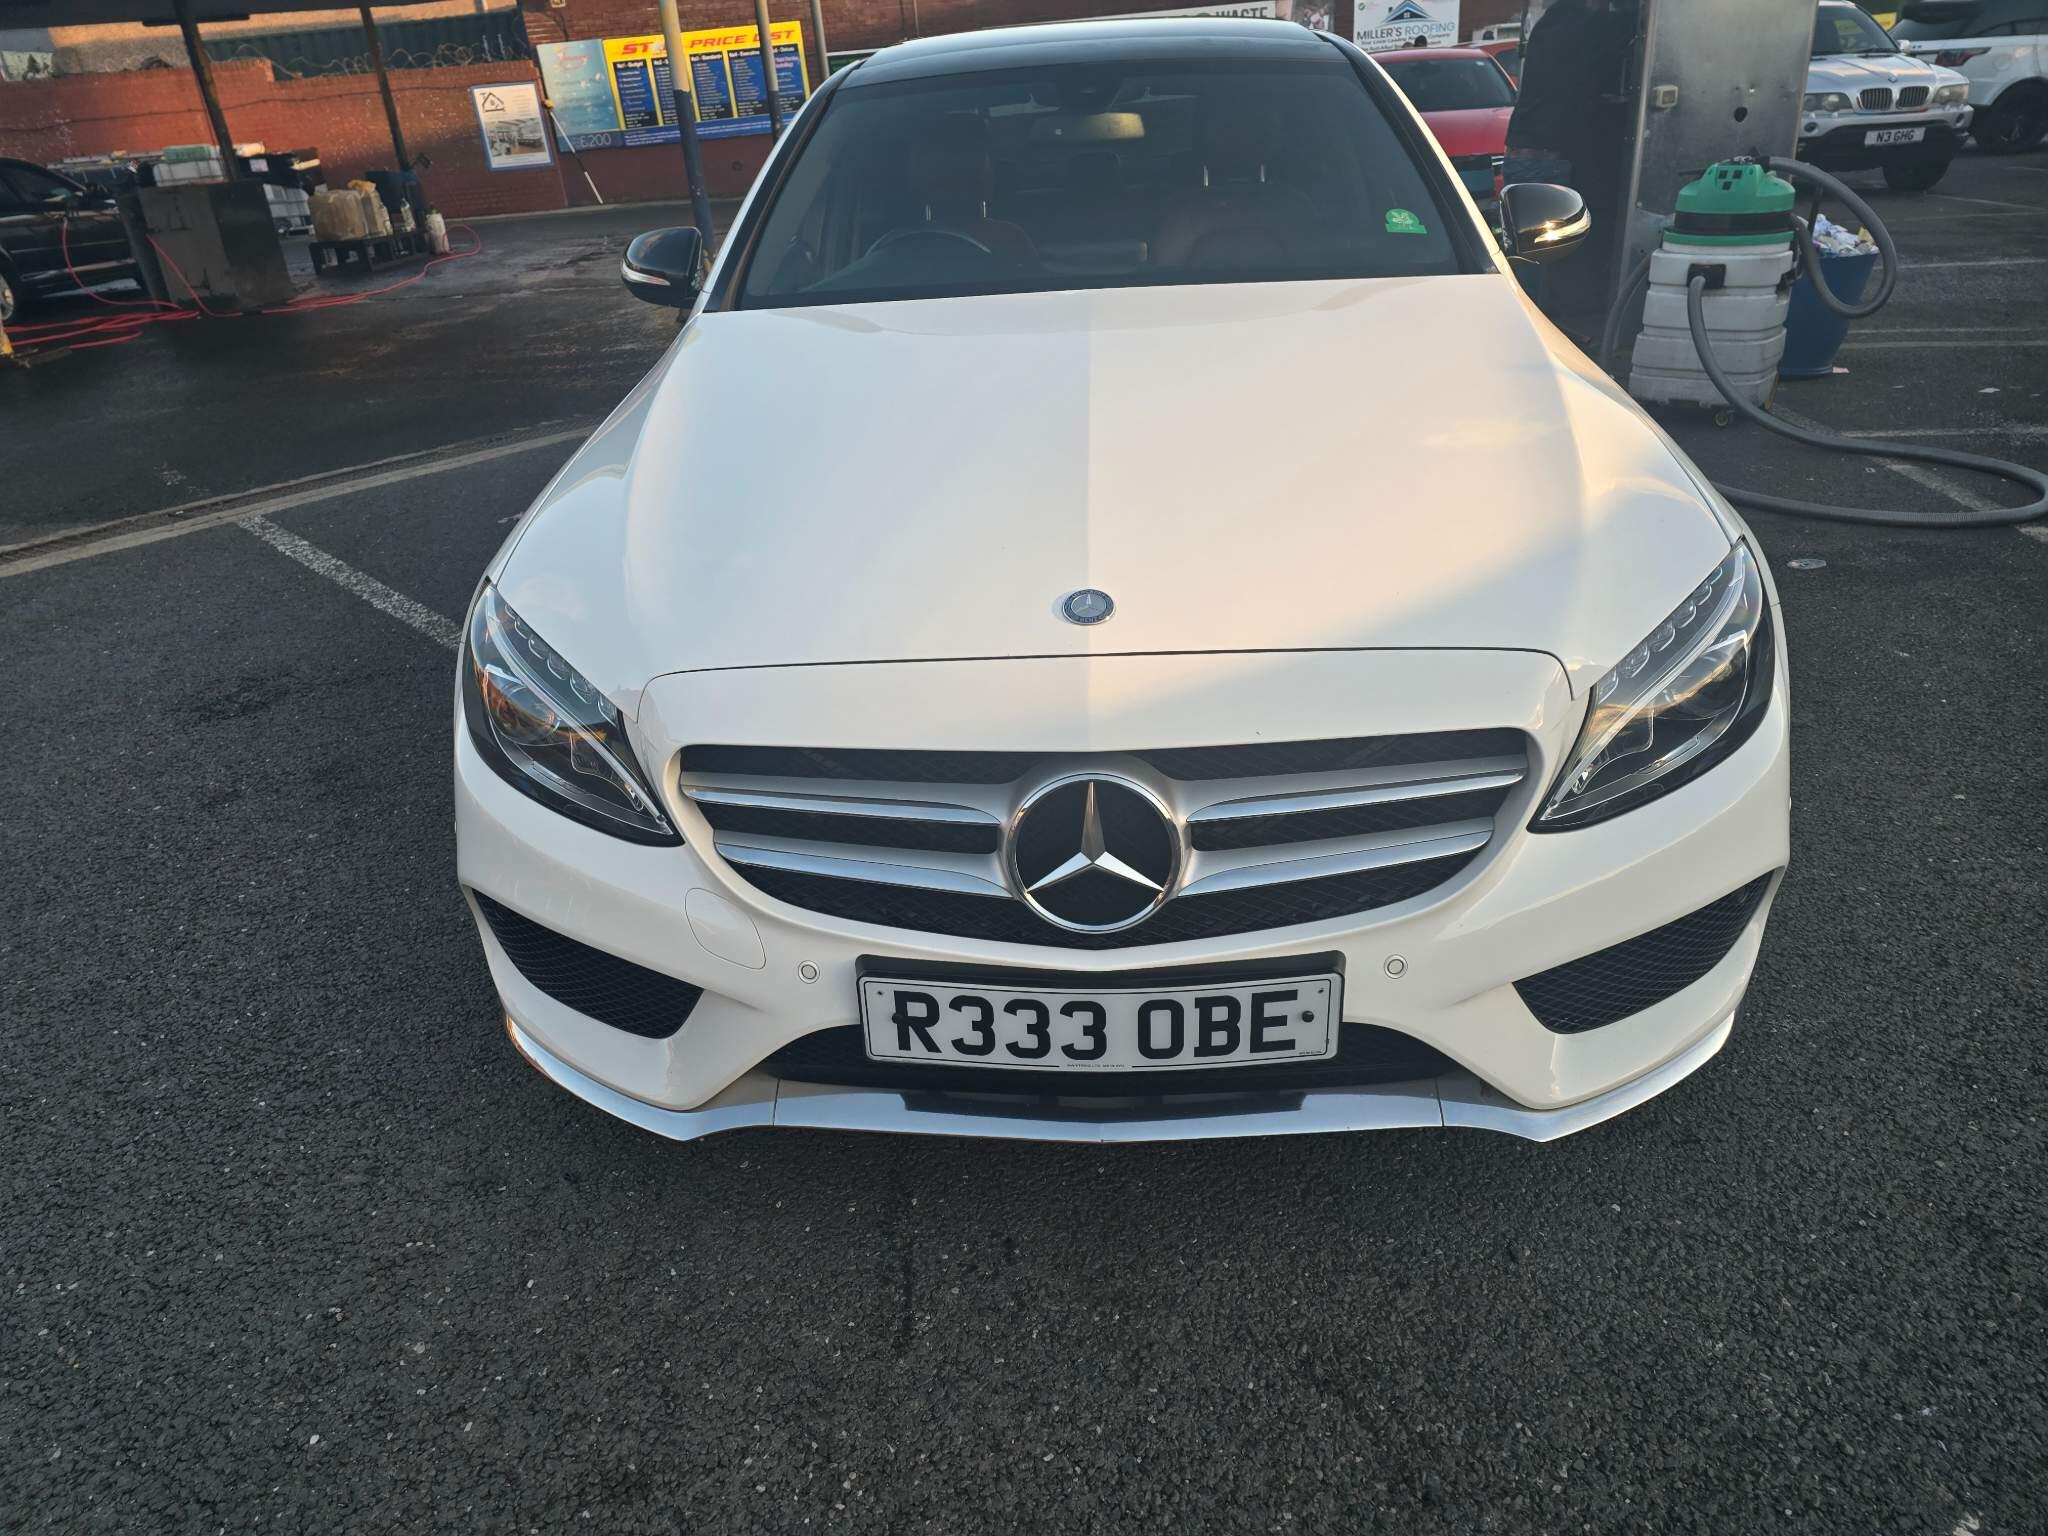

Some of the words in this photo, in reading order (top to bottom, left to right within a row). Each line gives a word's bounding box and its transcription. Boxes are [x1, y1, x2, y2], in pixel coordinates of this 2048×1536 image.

[690, 34, 748, 48] PRICE
[753, 30, 794, 42] LST
[1356, 26, 1402, 41] MILLER'S
[1404, 22, 1455, 36] ROOFING
[1876, 131, 1892, 143] N3
[893, 990, 1107, 1061] R333
[1137, 989, 1299, 1060] OBE
